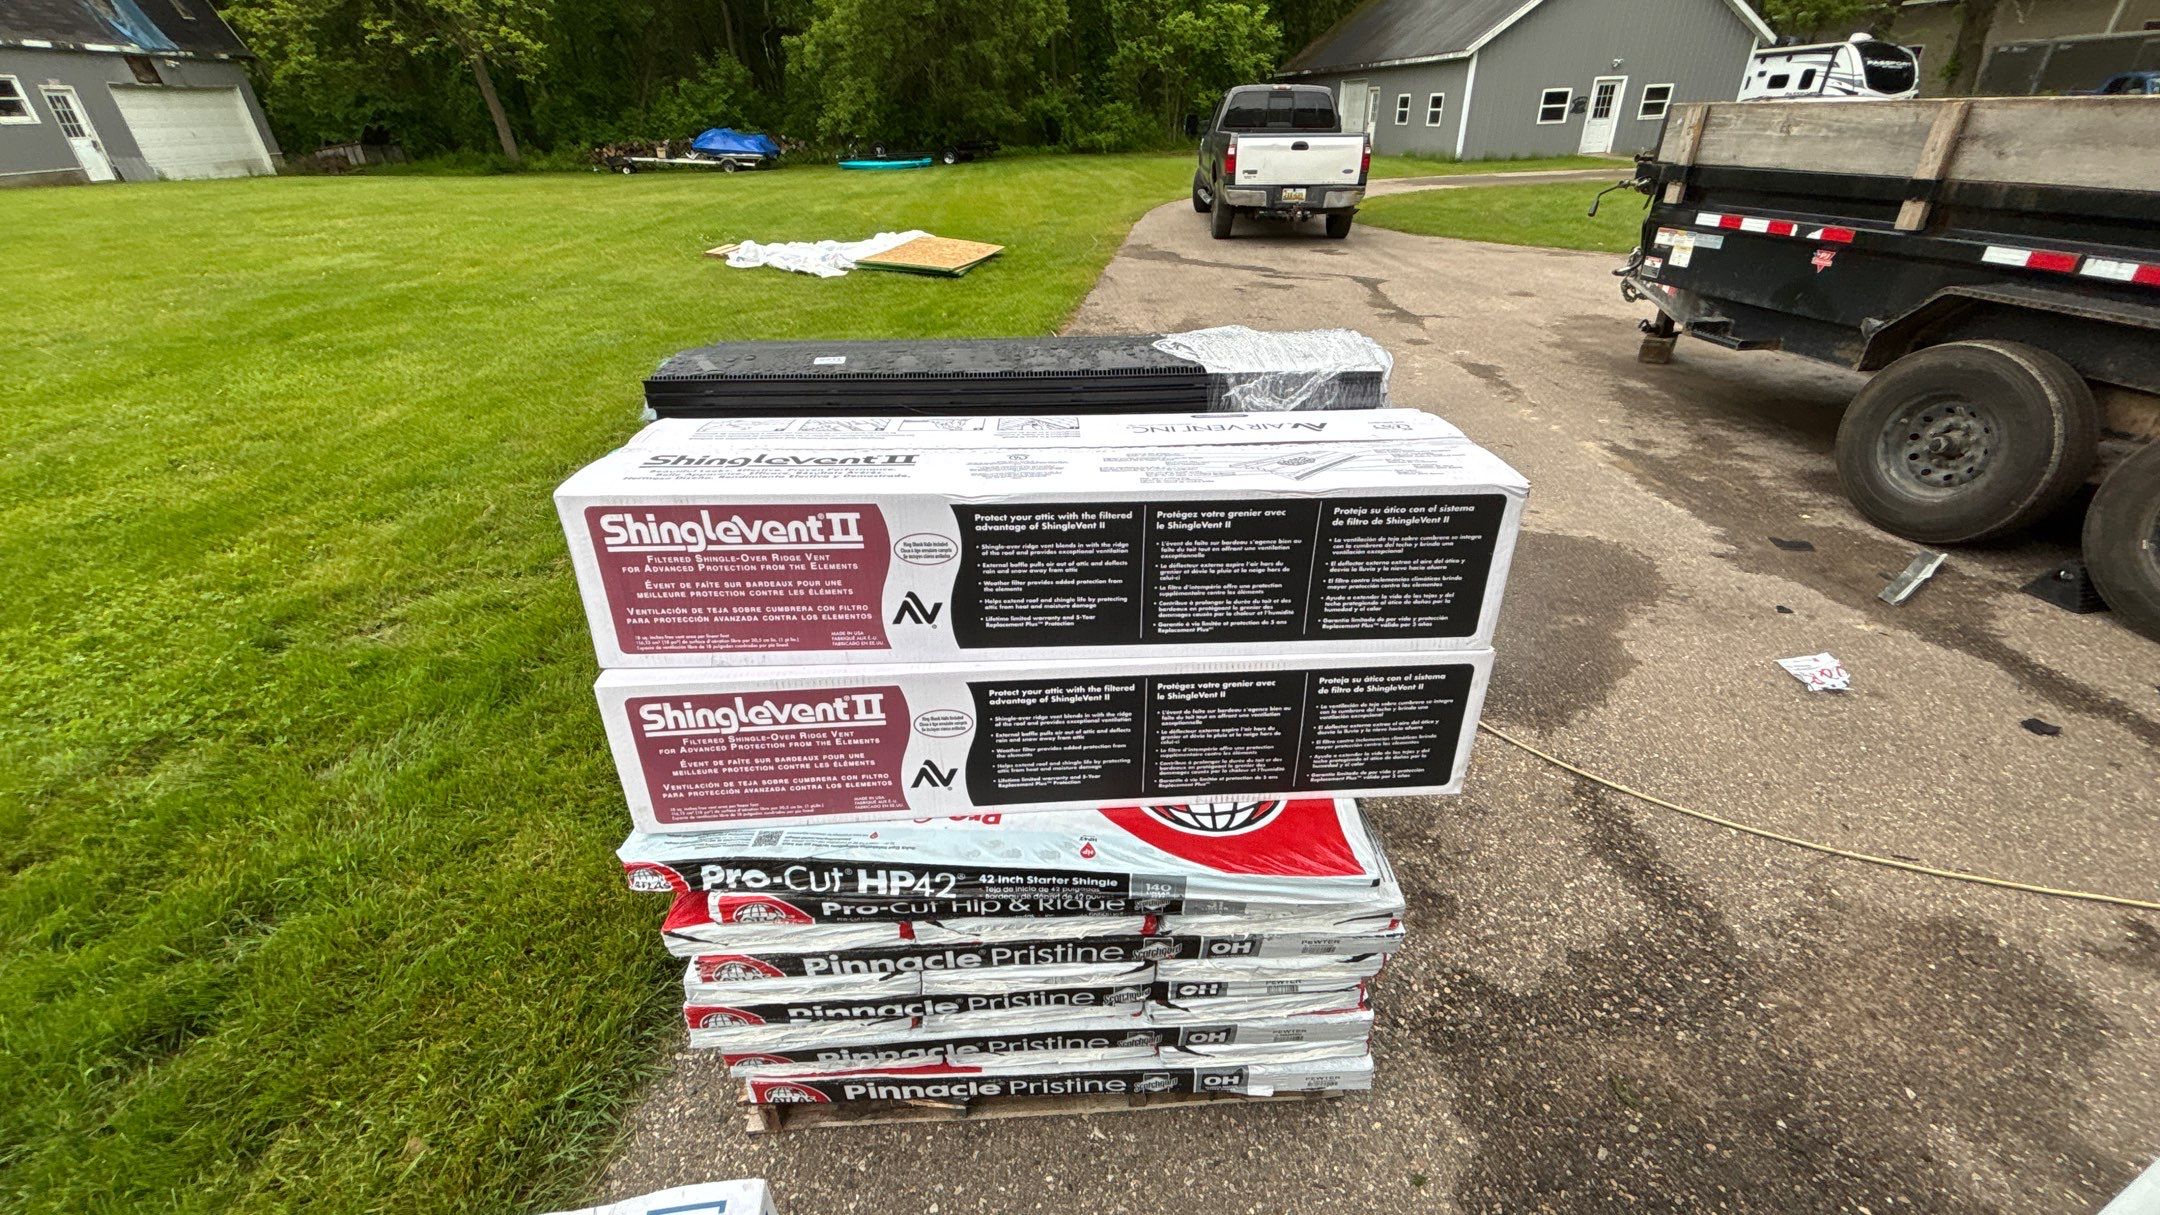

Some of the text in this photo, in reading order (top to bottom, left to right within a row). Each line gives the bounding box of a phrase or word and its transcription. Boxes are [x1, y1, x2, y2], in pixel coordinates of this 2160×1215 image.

[1248, 423, 1282, 431] AIR
[1099, 511, 1132, 519] filtered
[1157, 511, 1198, 520] Protégez
[1228, 511, 1262, 519] grenier
[1334, 507, 1367, 516] Proteja
[1168, 521, 1222, 531] ShingleVent
[1332, 518, 1344, 526] de
[1386, 516, 1441, 526] ShingleVent
[826, 512, 864, 542] II
[975, 523, 1026, 532] advantage
[1029, 522, 1039, 530] of
[1042, 522, 1097, 531] ShingleVent
[647, 555, 691, 563] FILTERED
[695, 554, 767, 562] SHINGLE-OVER
[644, 564, 694, 572] ADVANCED
[645, 580, 675, 589] ÉVENT
[627, 607, 688, 615] VENTILACIÓN
[1051, 694, 1102, 703] ShingleVent
[851, 694, 886, 720] II
[728, 733, 796, 742] SHINGLE-OVER
[979, 875, 995, 884] 42
[1026, 876, 1069, 885] Starter
[1072, 877, 1118, 887] Shingle
[1146, 883, 1172, 892] 140
[952, 900, 1000, 915] Hip
[1211, 942, 1252, 954] OH
[991, 944, 1124, 966] Pristine
[1180, 984, 1218, 995] OH
[968, 991, 1095, 1010] Pristine
[1189, 1032, 1226, 1043] OH
[988, 1036, 1109, 1052] Pristine
[1134, 1077, 1178, 1092] Scotchgard
[1204, 1076, 1239, 1085] OH
[1010, 1078, 1126, 1094] Pristine
